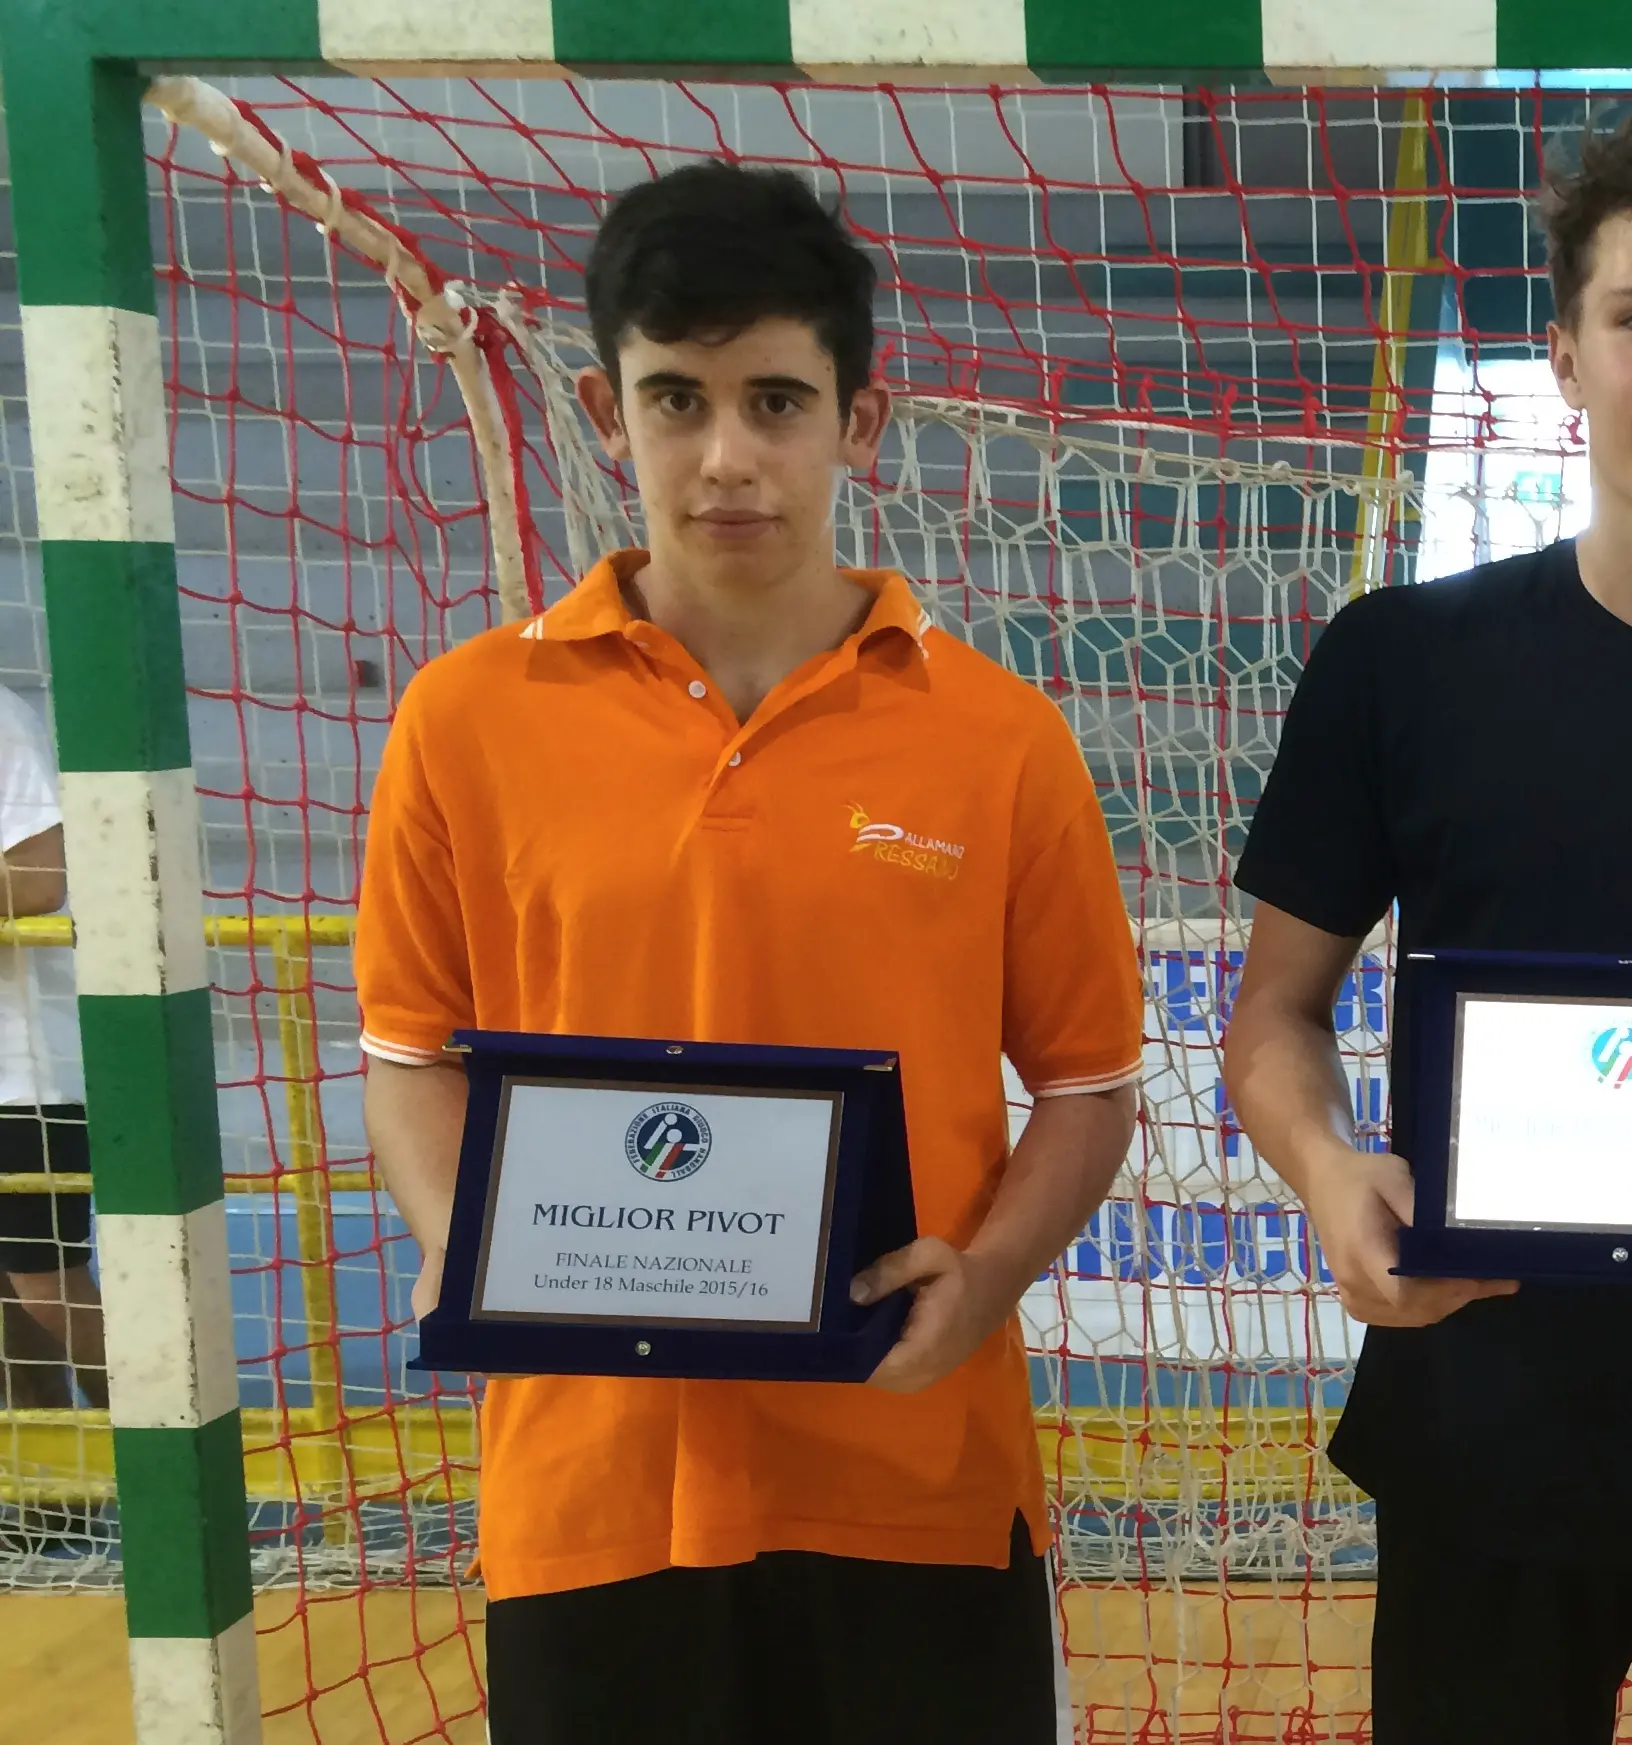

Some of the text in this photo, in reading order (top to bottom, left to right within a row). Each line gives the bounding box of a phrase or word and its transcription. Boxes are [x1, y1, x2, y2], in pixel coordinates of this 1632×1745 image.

[651, 1104, 691, 1116] ITALIANA
[533, 1204, 784, 1234] MIGLIOR PIVOT
[556, 1253, 751, 1273] FINALE NAZIONALE
[535, 1274, 768, 1298] Under 18 Maschile 2015/16
